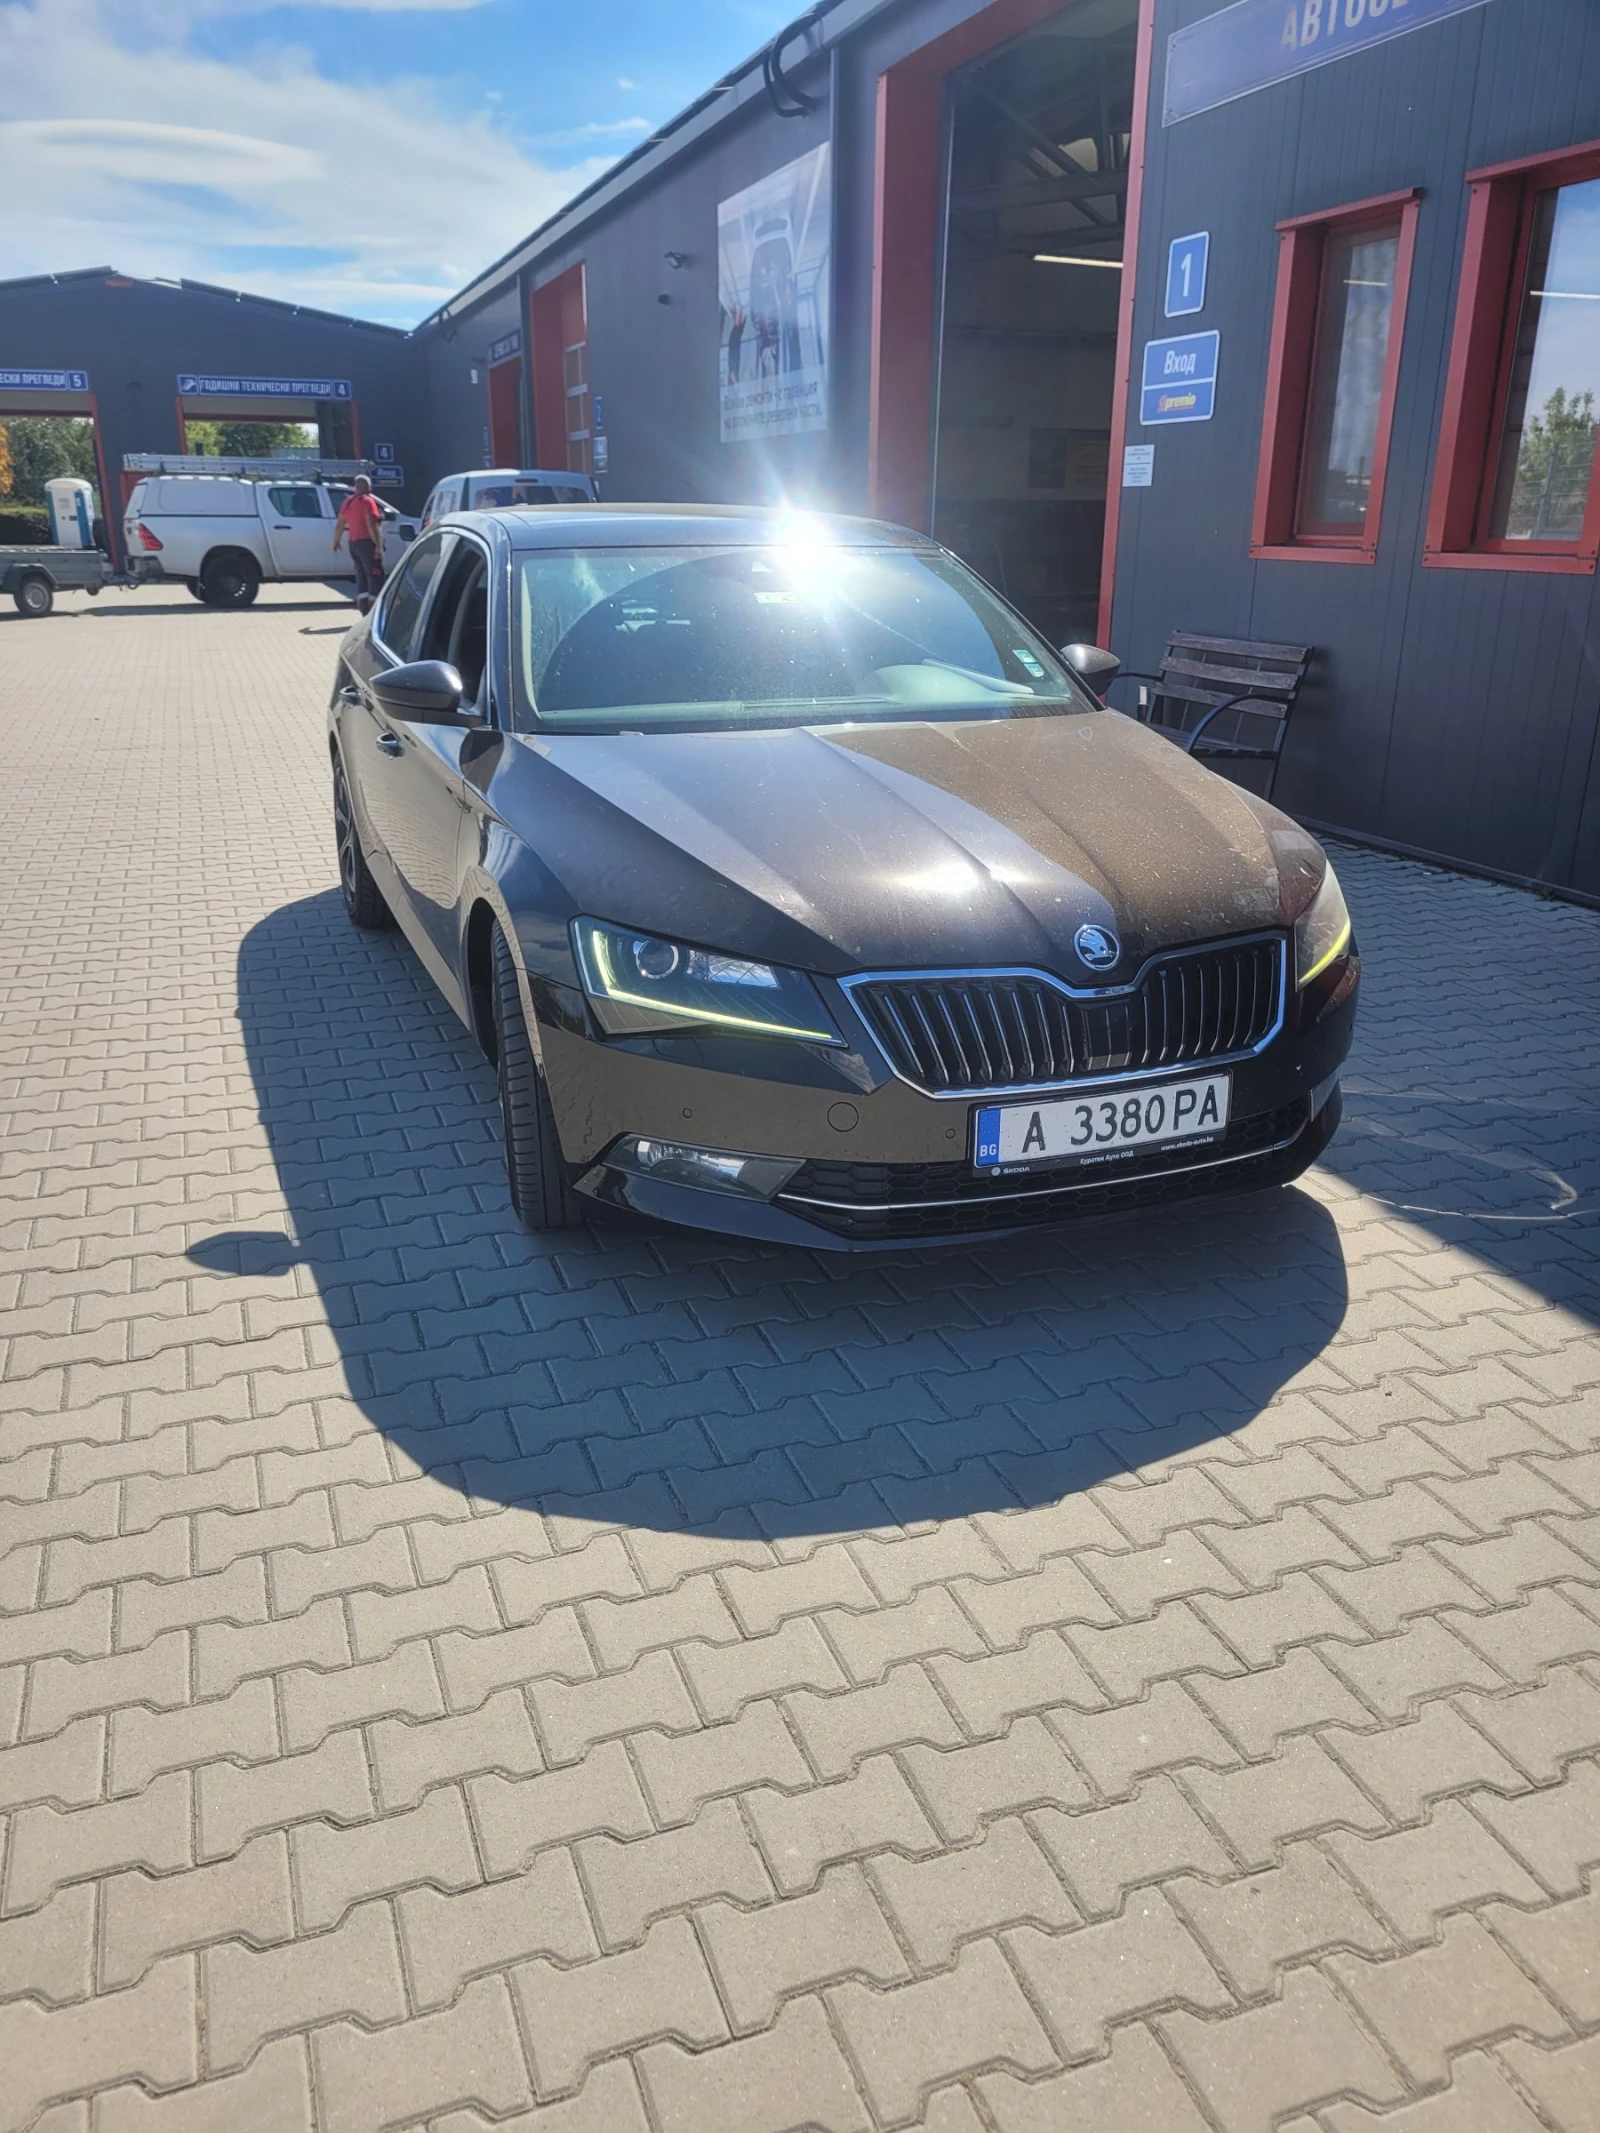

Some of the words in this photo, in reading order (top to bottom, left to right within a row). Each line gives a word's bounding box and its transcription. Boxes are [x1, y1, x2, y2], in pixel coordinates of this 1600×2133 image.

[1280, 0, 1409, 50] АВТО
[1180, 253, 1192, 297] 1
[1164, 350, 1197, 375] Вход
[73, 375, 82, 387] 5
[201, 379, 240, 391] ГОДИШНИ
[241, 380, 290, 393] ТЕХНИЧЕСКИ
[292, 382, 331, 394] ПРЕГЛЕДИ
[338, 384, 346, 395] 4
[1164, 392, 1197, 411] premio
[1021, 1111, 1046, 1153] A
[1070, 1094, 1165, 1147] 3380
[980, 1144, 997, 1157] BG
